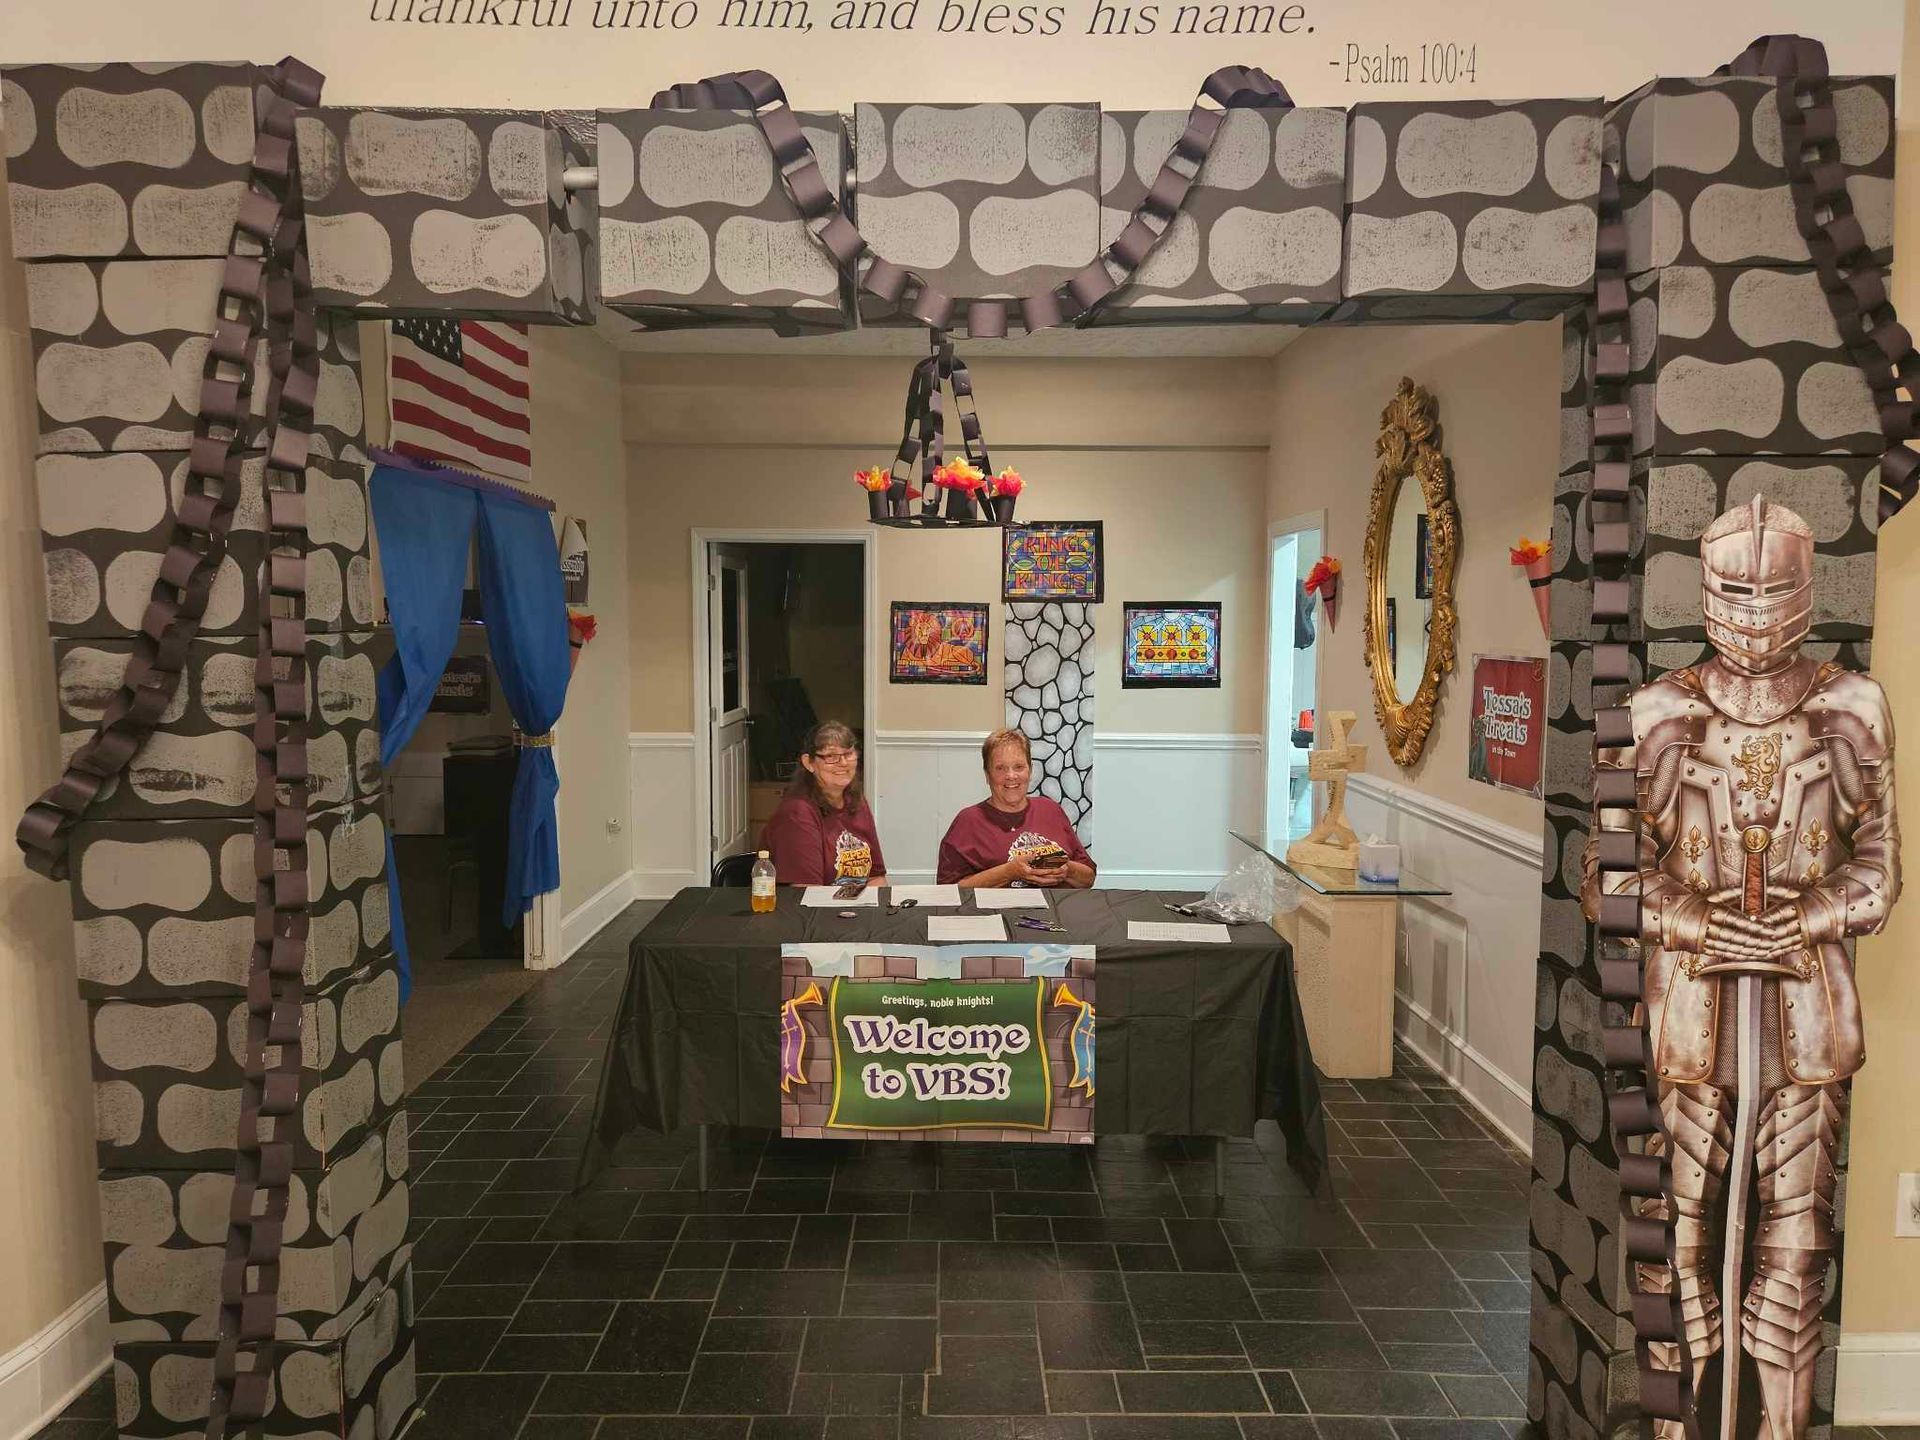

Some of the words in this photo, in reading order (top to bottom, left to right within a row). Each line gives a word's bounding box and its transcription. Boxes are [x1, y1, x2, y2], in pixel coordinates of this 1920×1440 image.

[592, 0, 699, 29] unto
[717, 0, 816, 34] him,
[830, 0, 918, 30] and
[937, 0, 1065, 35] bless
[1085, 0, 1160, 35] his
[1170, 3, 1315, 35] name.
[1329, 43, 1409, 84] -Psalm
[1419, 43, 1477, 84] 100:4
[1483, 687, 1531, 719] Tessa's
[1484, 714, 1527, 745] Treats
[881, 995, 928, 1009] Greetings,
[930, 997, 954, 1008] noble
[956, 995, 994, 1009] knights!
[848, 1019, 1026, 1054] Welcome
[866, 1067, 901, 1095] to
[911, 1066, 1006, 1097] VBS!
